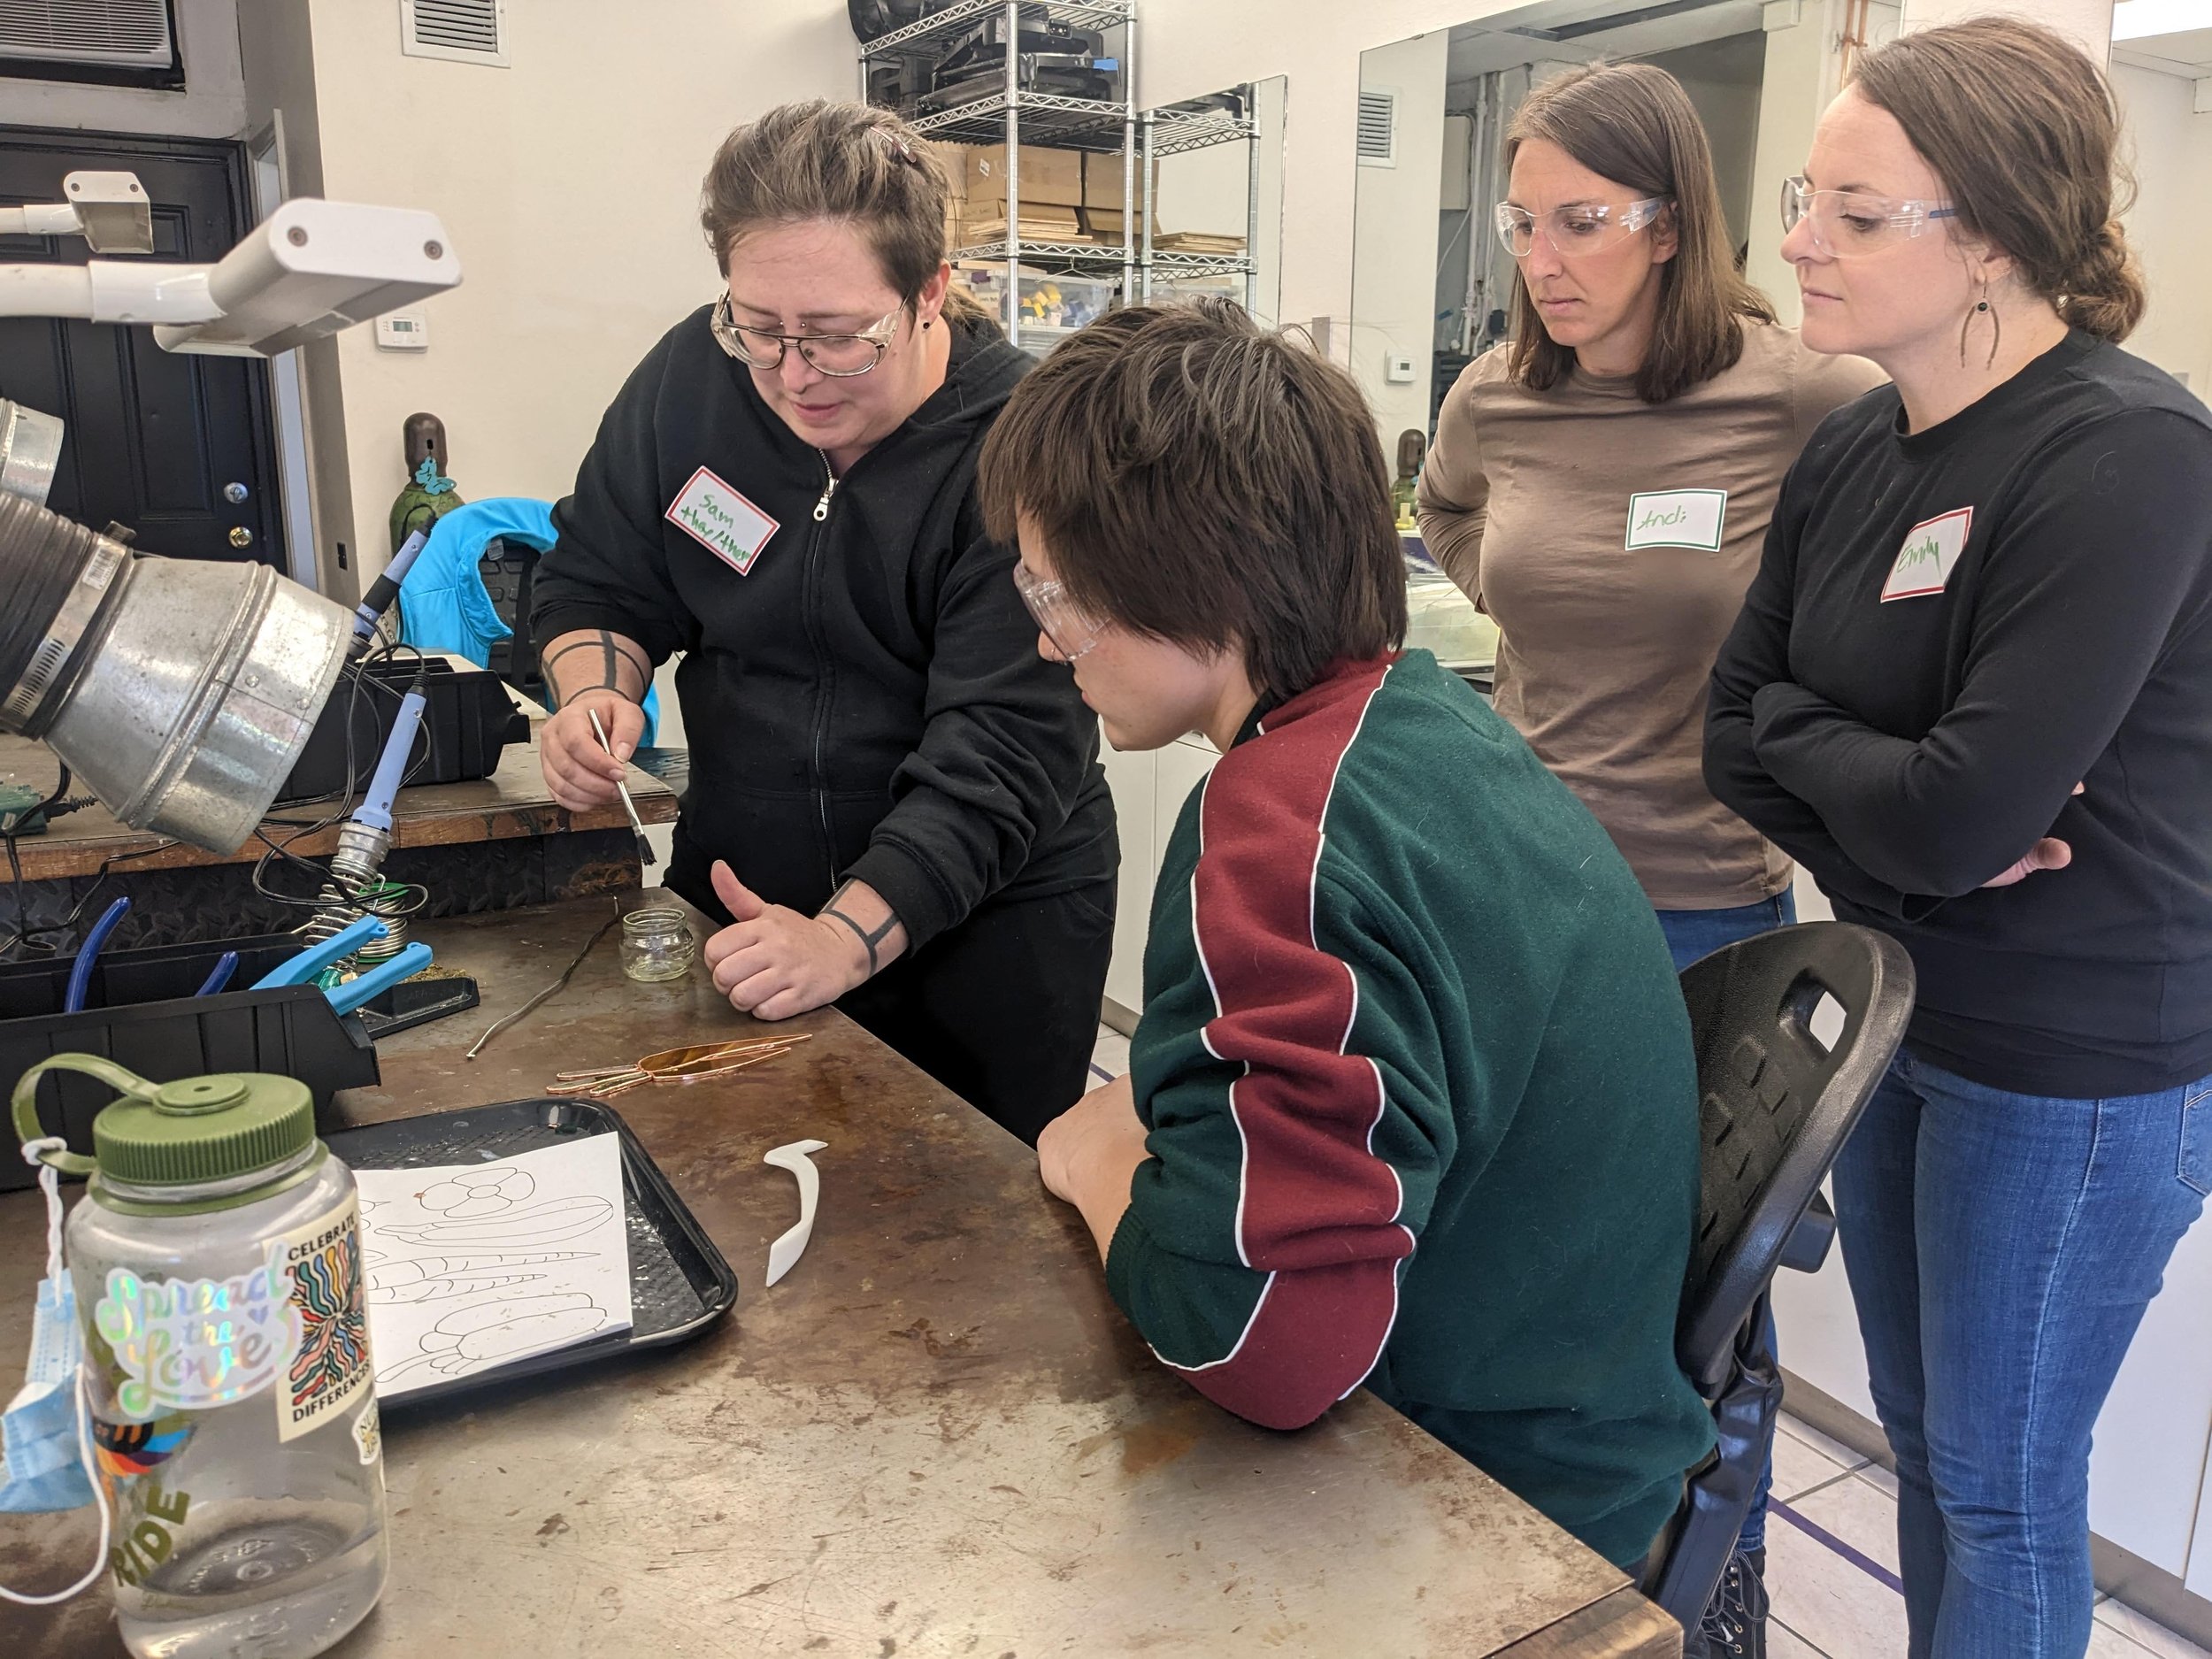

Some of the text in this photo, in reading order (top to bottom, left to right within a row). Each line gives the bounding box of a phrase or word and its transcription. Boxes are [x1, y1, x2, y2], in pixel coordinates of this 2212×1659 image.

[699, 494, 734, 529] Sam
[288, 1210, 356, 1261] CELEBRATE
[98, 1244, 287, 1341] Spread
[181, 1320, 244, 1347] the
[121, 1328, 274, 1413] Love
